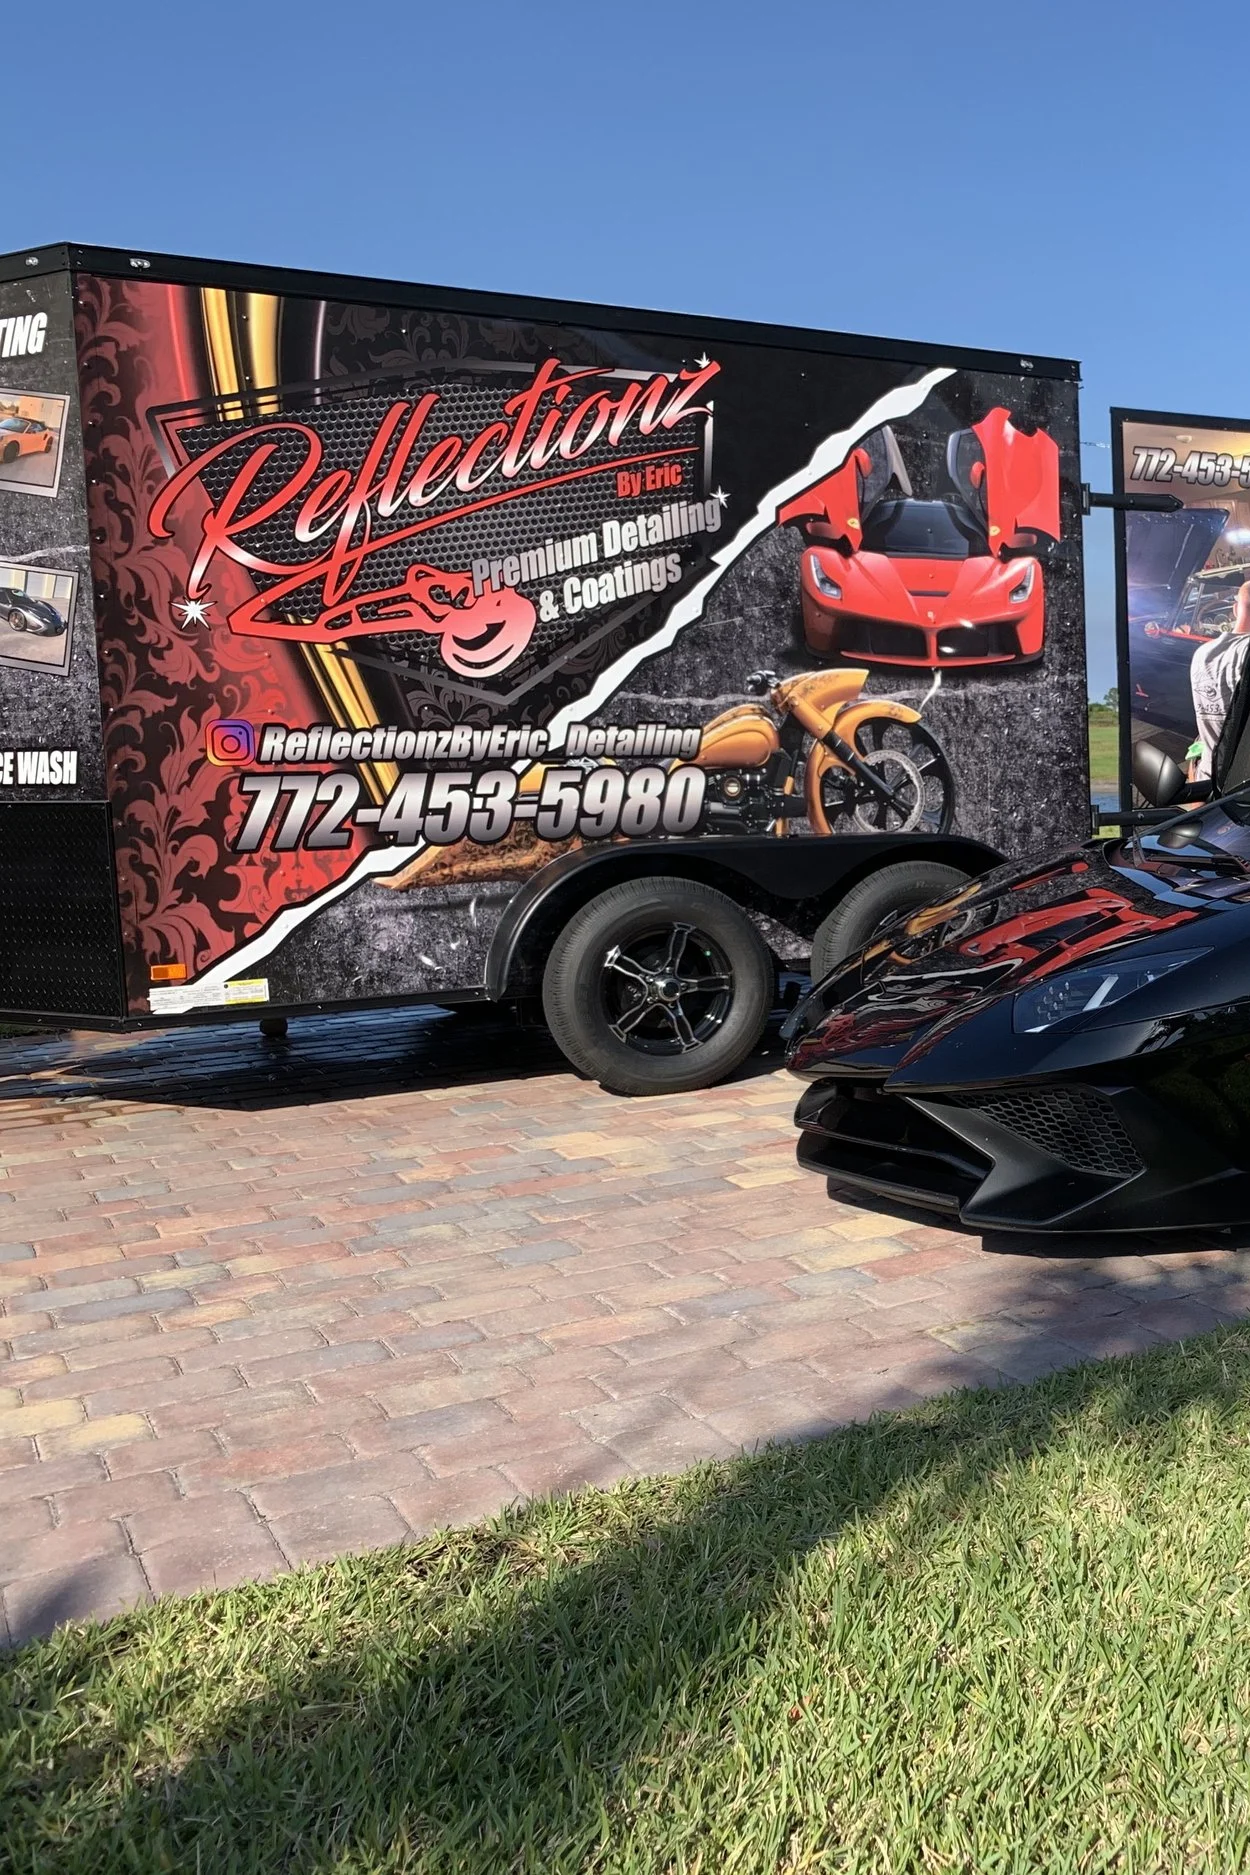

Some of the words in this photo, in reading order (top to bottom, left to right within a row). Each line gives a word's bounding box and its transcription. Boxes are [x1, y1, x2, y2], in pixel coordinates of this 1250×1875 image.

[148, 355, 723, 607] Reflectionz
[616, 470, 641, 498] By
[646, 462, 683, 491] Eric
[472, 531, 599, 597] Premium
[602, 499, 723, 559] Detailing
[539, 590, 560, 623] &
[563, 552, 683, 615] Coatings
[0, 751, 14, 785] E
[17, 750, 78, 786] WASH
[235, 766, 707, 851] 772-453-5980
